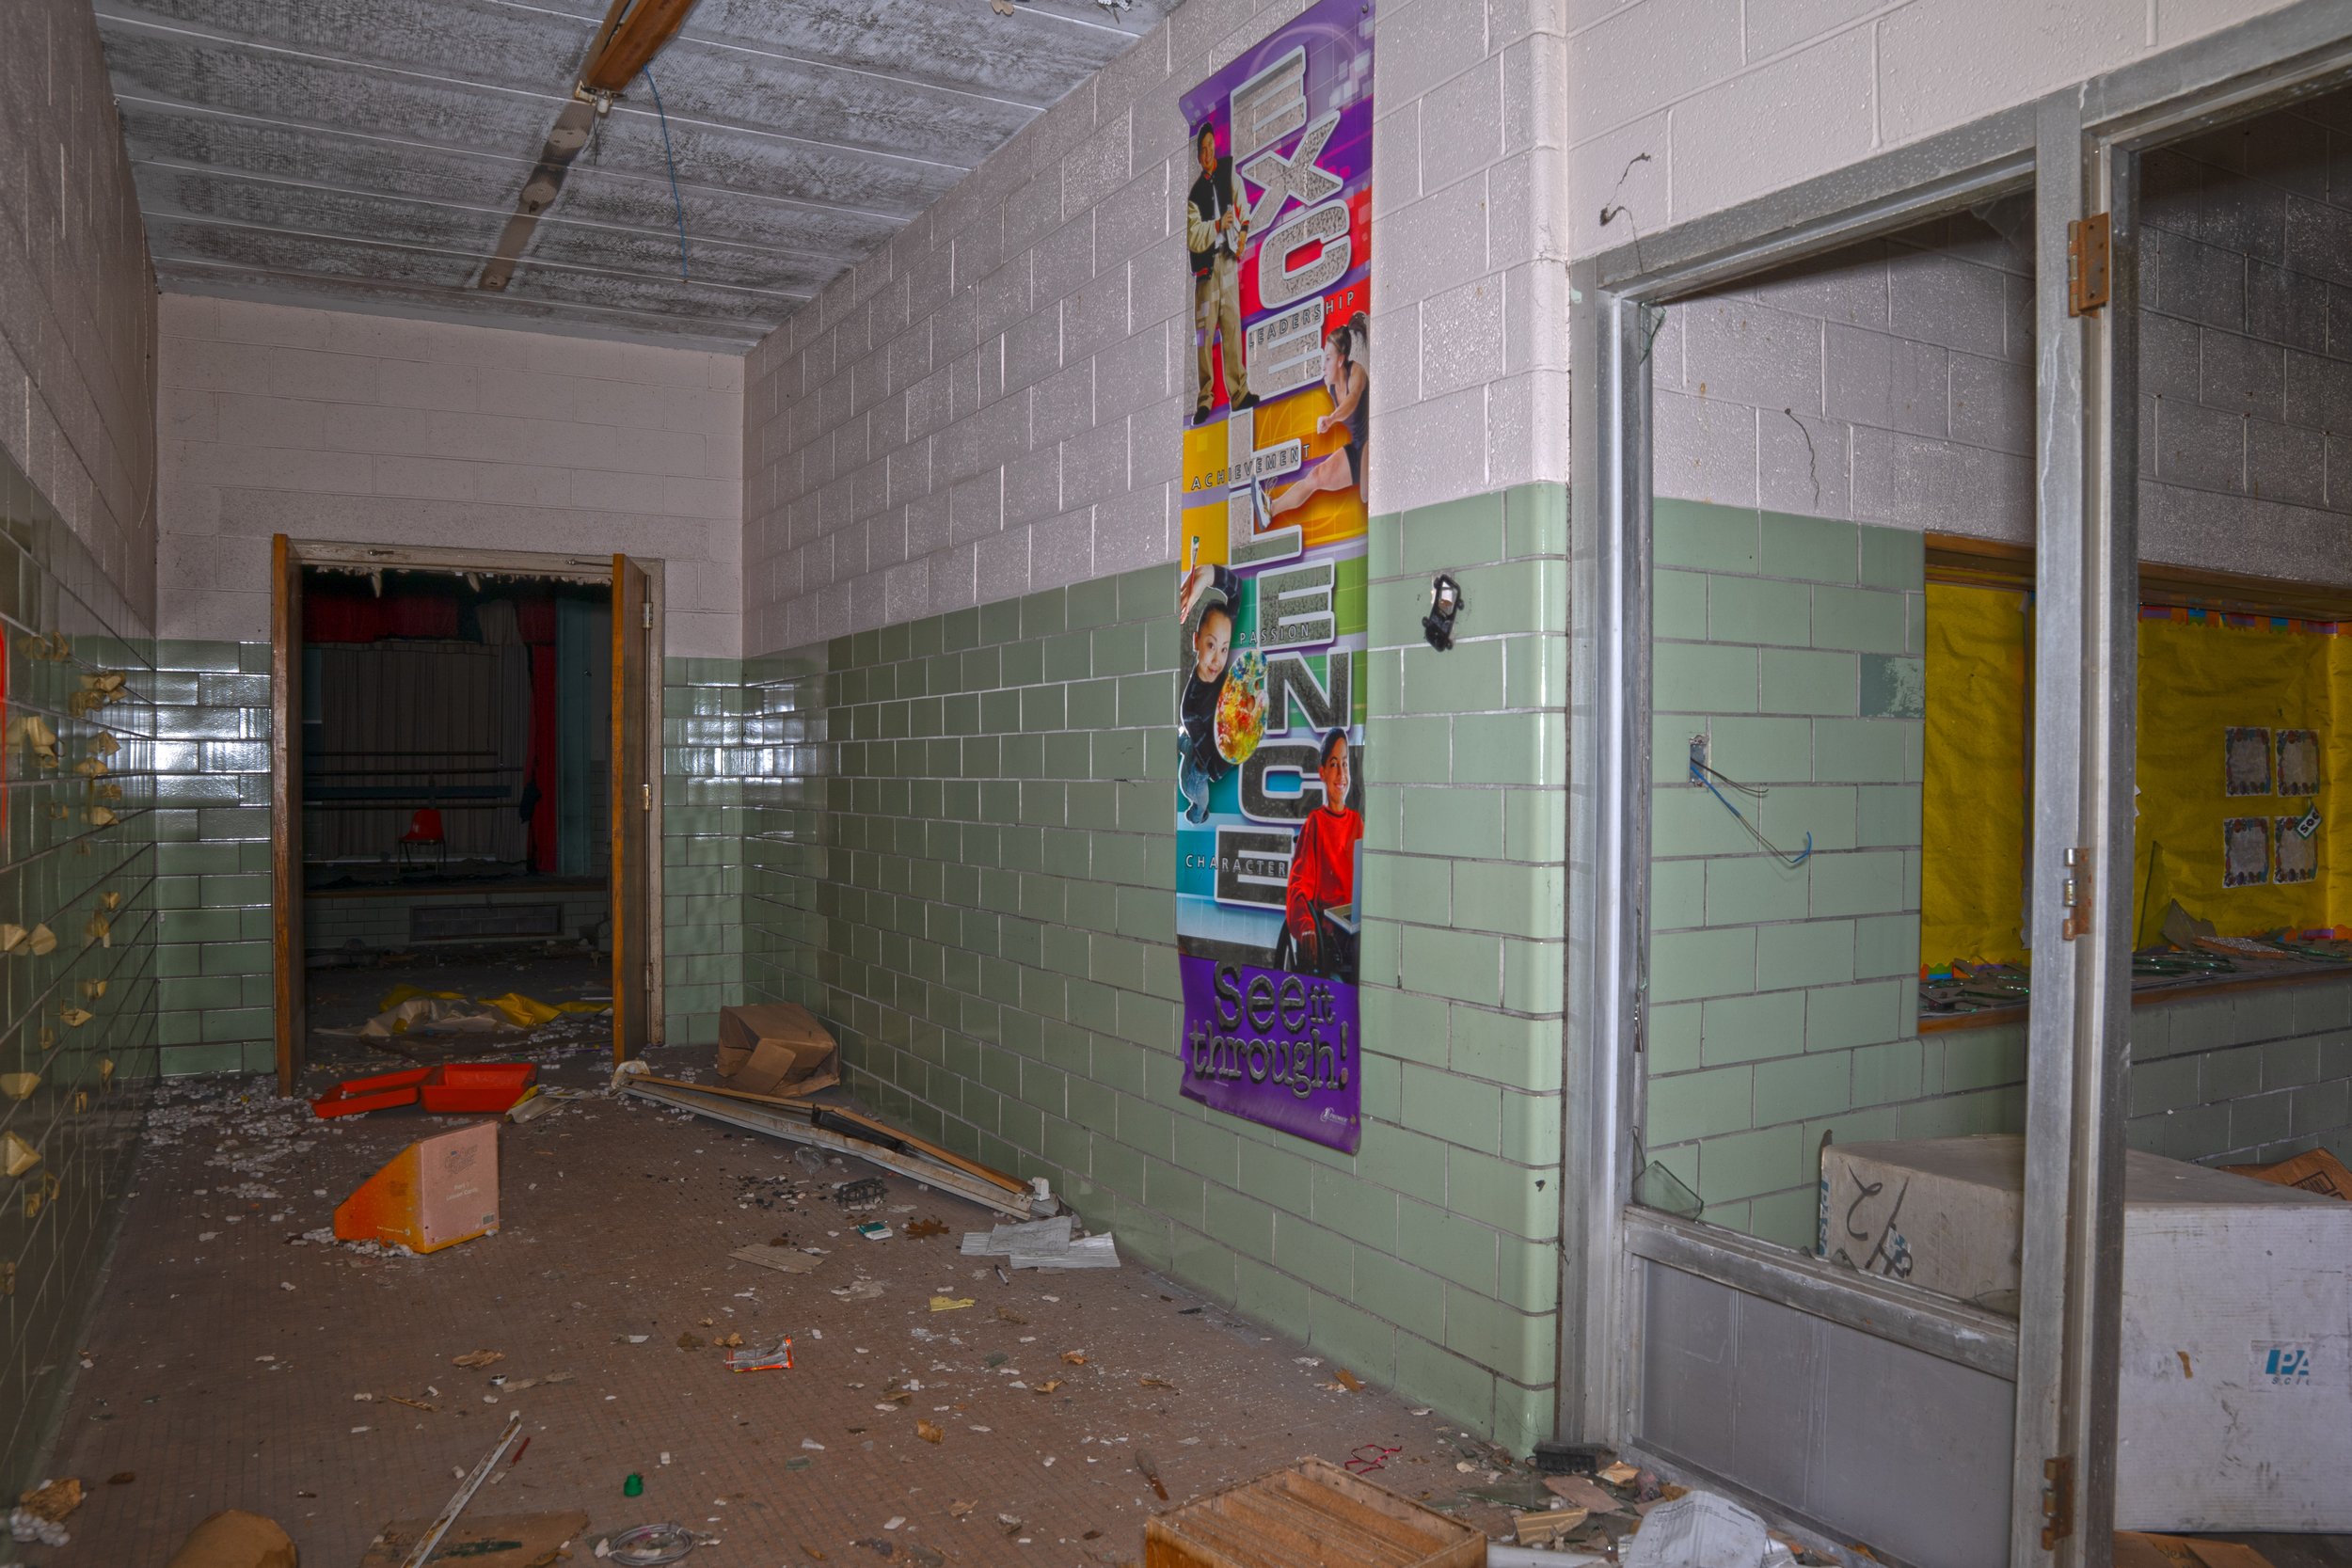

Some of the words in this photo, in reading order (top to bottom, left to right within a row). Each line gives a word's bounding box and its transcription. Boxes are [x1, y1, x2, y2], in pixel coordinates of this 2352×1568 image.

[1248, 291, 1355, 348] LEADERSHIP
[1191, 444, 1311, 490] ACHIEVEMENT
[1239, 622, 1311, 646] PASSION
[1184, 853, 1286, 877] CHARACTER
[1213, 960, 1306, 1034] See
[1308, 982, 1336, 1026] it
[1189, 1021, 1349, 1099] through!
